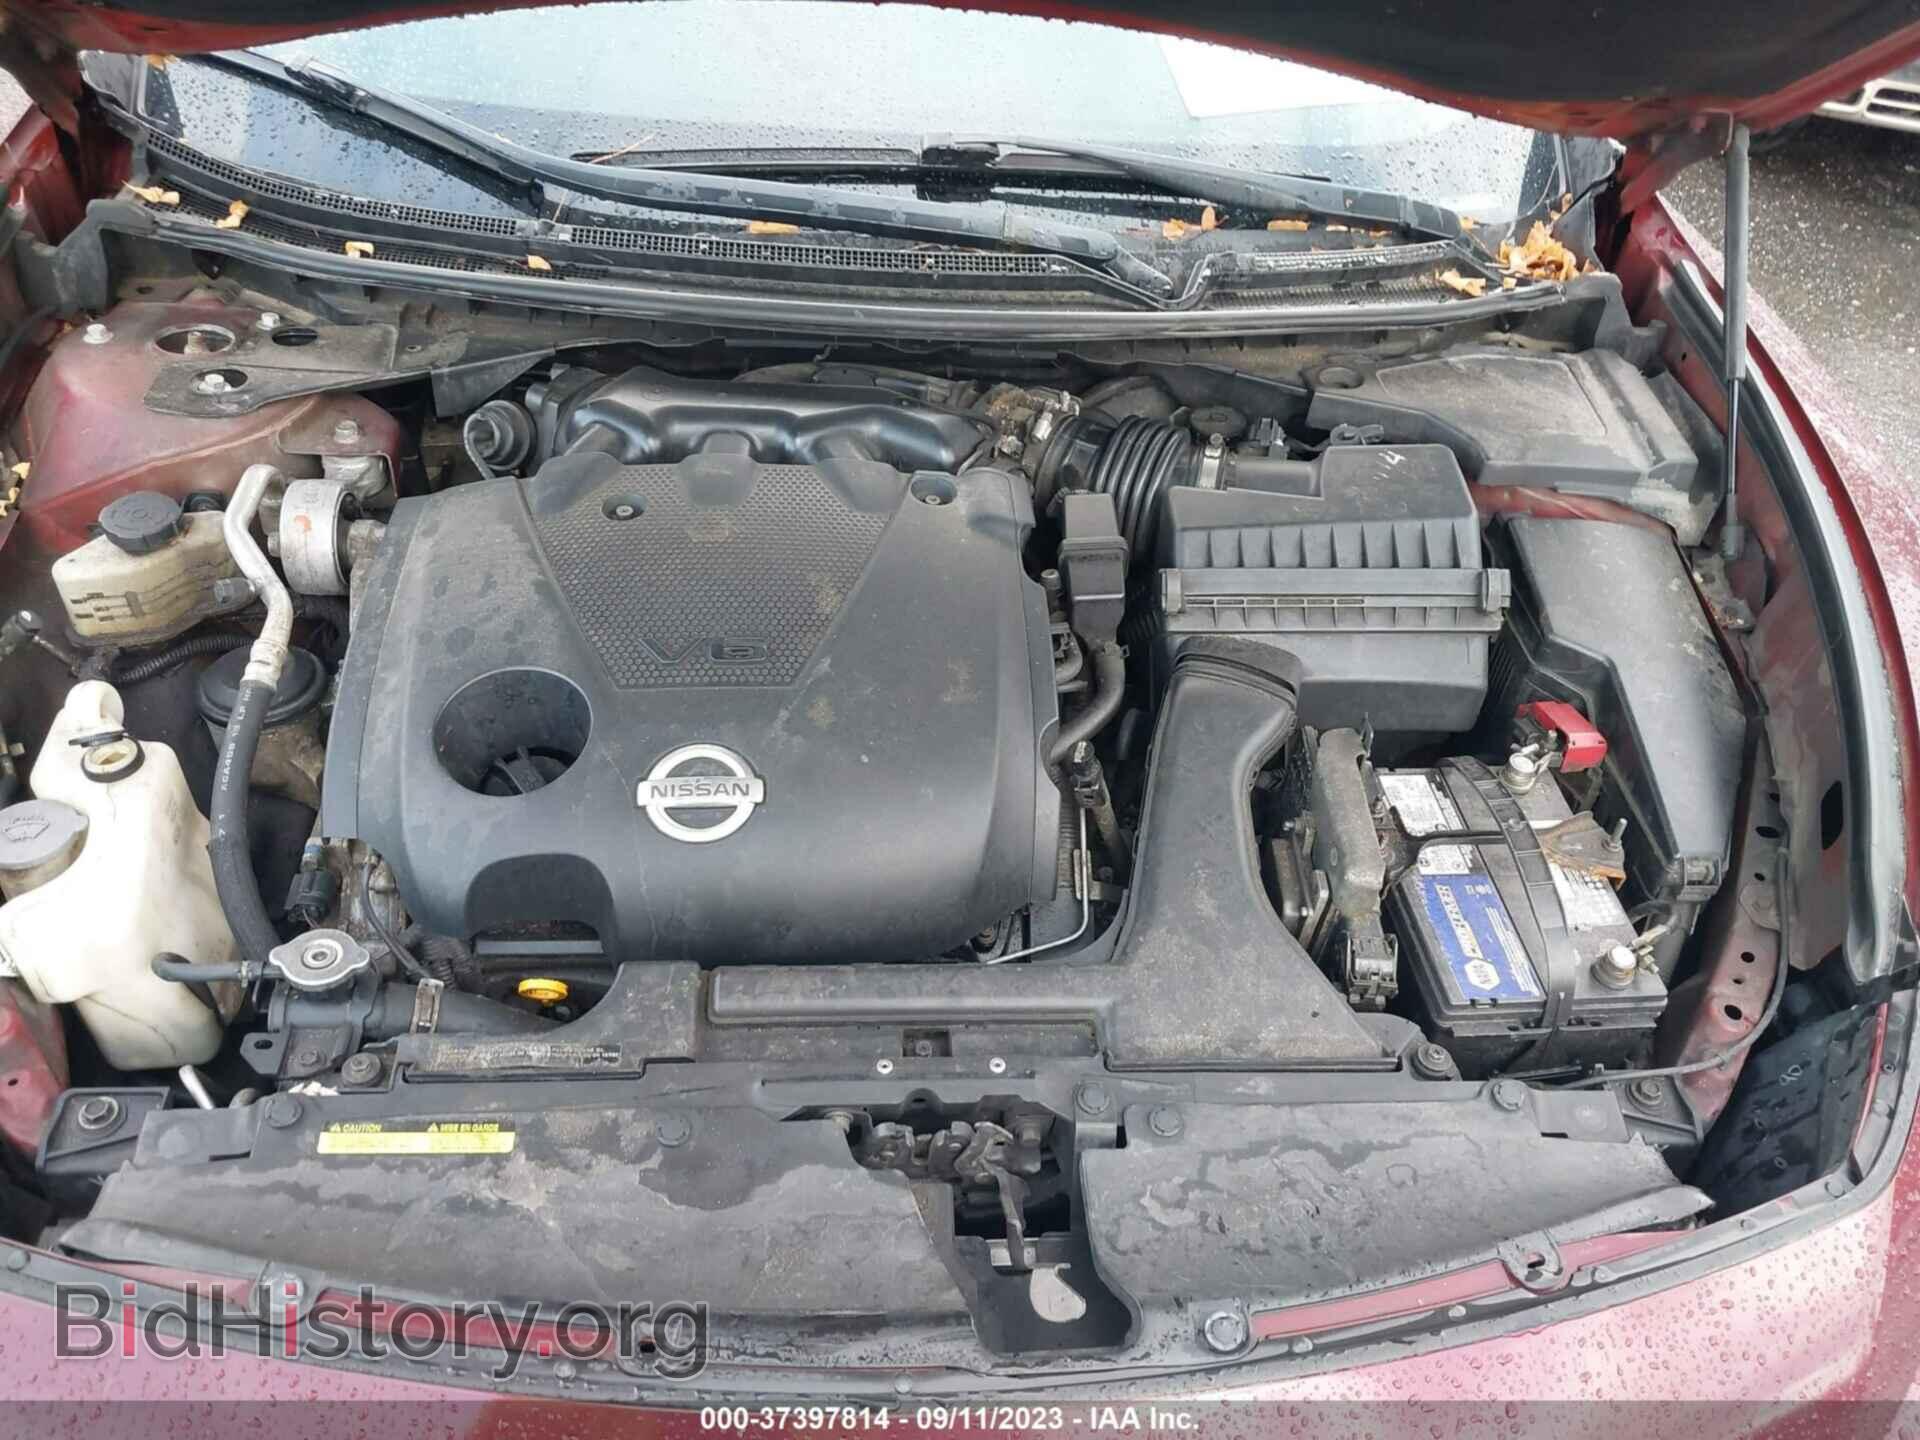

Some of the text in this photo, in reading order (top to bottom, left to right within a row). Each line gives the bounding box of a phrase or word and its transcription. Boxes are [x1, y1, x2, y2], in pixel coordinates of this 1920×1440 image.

[636, 635, 768, 665] V6
[650, 782, 750, 799] NISSAN
[343, 1122, 382, 1133] CAUTION
